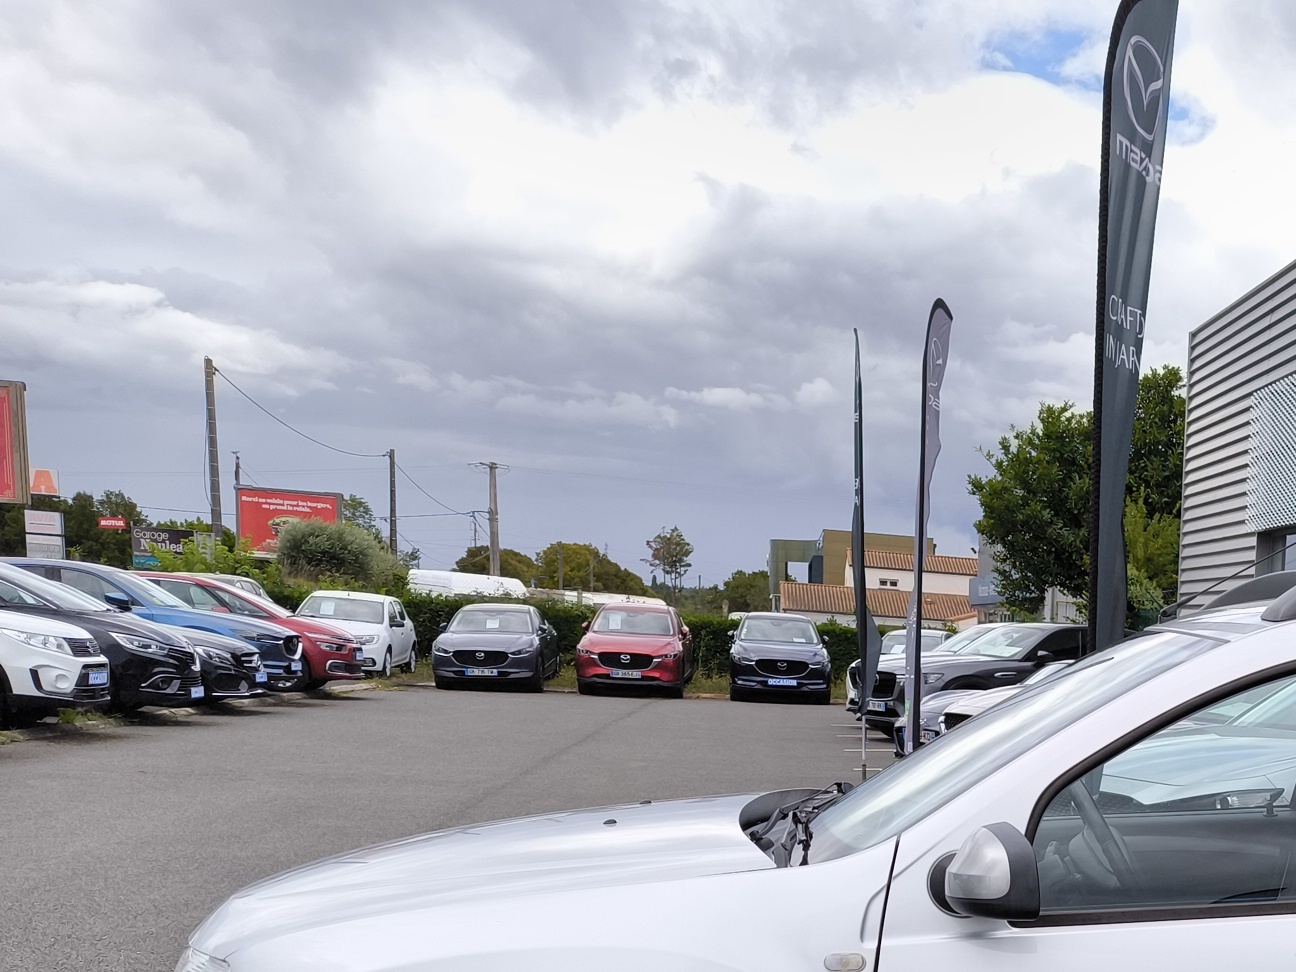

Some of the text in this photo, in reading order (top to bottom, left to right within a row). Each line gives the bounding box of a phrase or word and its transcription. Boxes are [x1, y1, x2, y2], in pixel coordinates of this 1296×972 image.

[100, 519, 125, 527] MOTUL
[133, 528, 169, 542] Garage
[767, 678, 798, 687] OCCASION
